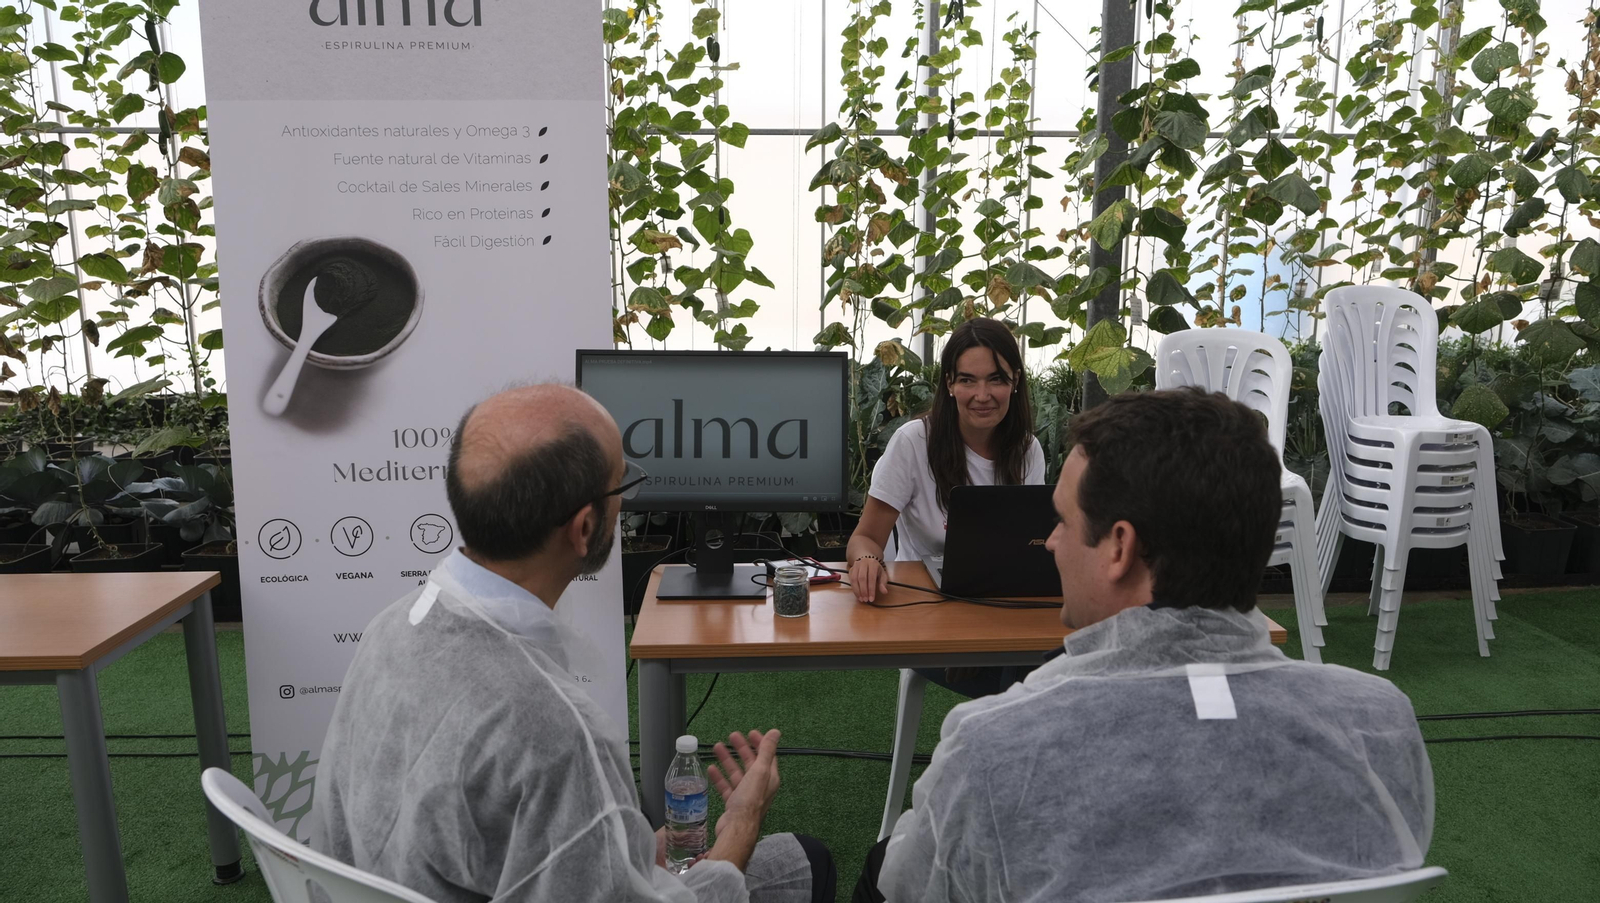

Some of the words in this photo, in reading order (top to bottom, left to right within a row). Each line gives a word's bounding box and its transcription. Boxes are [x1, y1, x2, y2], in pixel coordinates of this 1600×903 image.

[281, 125, 380, 138] Antioxidantes
[383, 125, 450, 138] naturales
[453, 127, 462, 140] y
[465, 125, 519, 140] Omega
[522, 125, 531, 138] 3
[333, 152, 384, 165] Fuente
[388, 152, 438, 165] natural
[441, 152, 460, 165] de
[463, 152, 532, 165] Vitaminas
[337, 180, 396, 194] Cocktail
[399, 180, 418, 193] de
[422, 180, 461, 193] Sales
[465, 179, 533, 193] Minerales
[412, 207, 443, 220] Rico
[447, 210, 465, 220] en
[470, 207, 534, 220] Proteinas
[434, 235, 467, 248] Fácil
[470, 234, 535, 251] Digestión
[622, 398, 808, 460] alma
[392, 427, 456, 449] 100%
[641, 475, 722, 487] SPIRULINA
[260, 574, 309, 584] ECOLÓGICA
[336, 571, 374, 580] VEGANA
[400, 570, 428, 578] SIERRA
